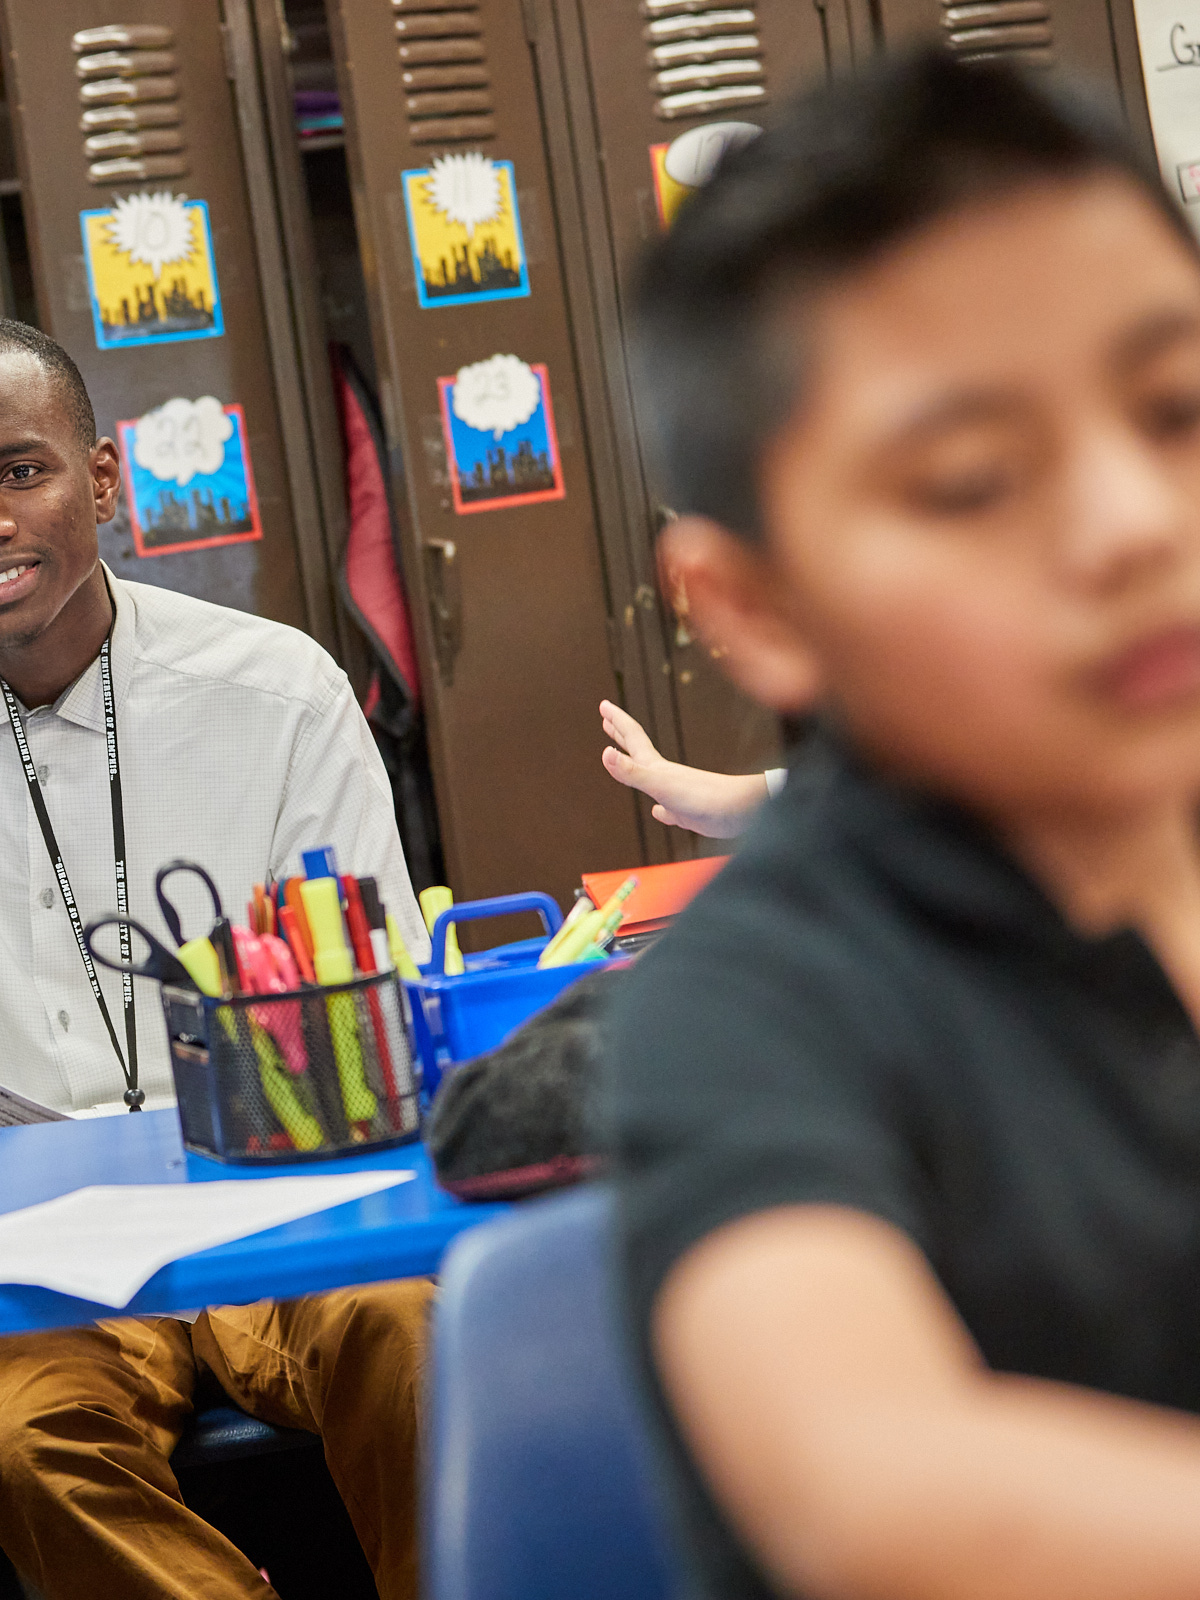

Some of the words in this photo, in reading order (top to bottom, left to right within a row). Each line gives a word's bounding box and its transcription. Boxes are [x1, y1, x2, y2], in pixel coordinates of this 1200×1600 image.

[452, 165, 472, 206] 11
[133, 209, 171, 251] 10
[472, 368, 513, 408] 23
[154, 413, 208, 460] 22
[5, 692, 14, 703] OF
[101, 656, 113, 714] UNIVERSITY
[9, 705, 30, 761] UNIVERSITY
[106, 717, 114, 728] OF
[25, 763, 36, 782] THE
[116, 861, 124, 879] THE
[69, 907, 78, 919] OF
[73, 921, 94, 978] UNIVERSITY
[121, 944, 130, 956] OF
[91, 980, 101, 998] THE
[122, 958, 132, 1002] MMPHIS
